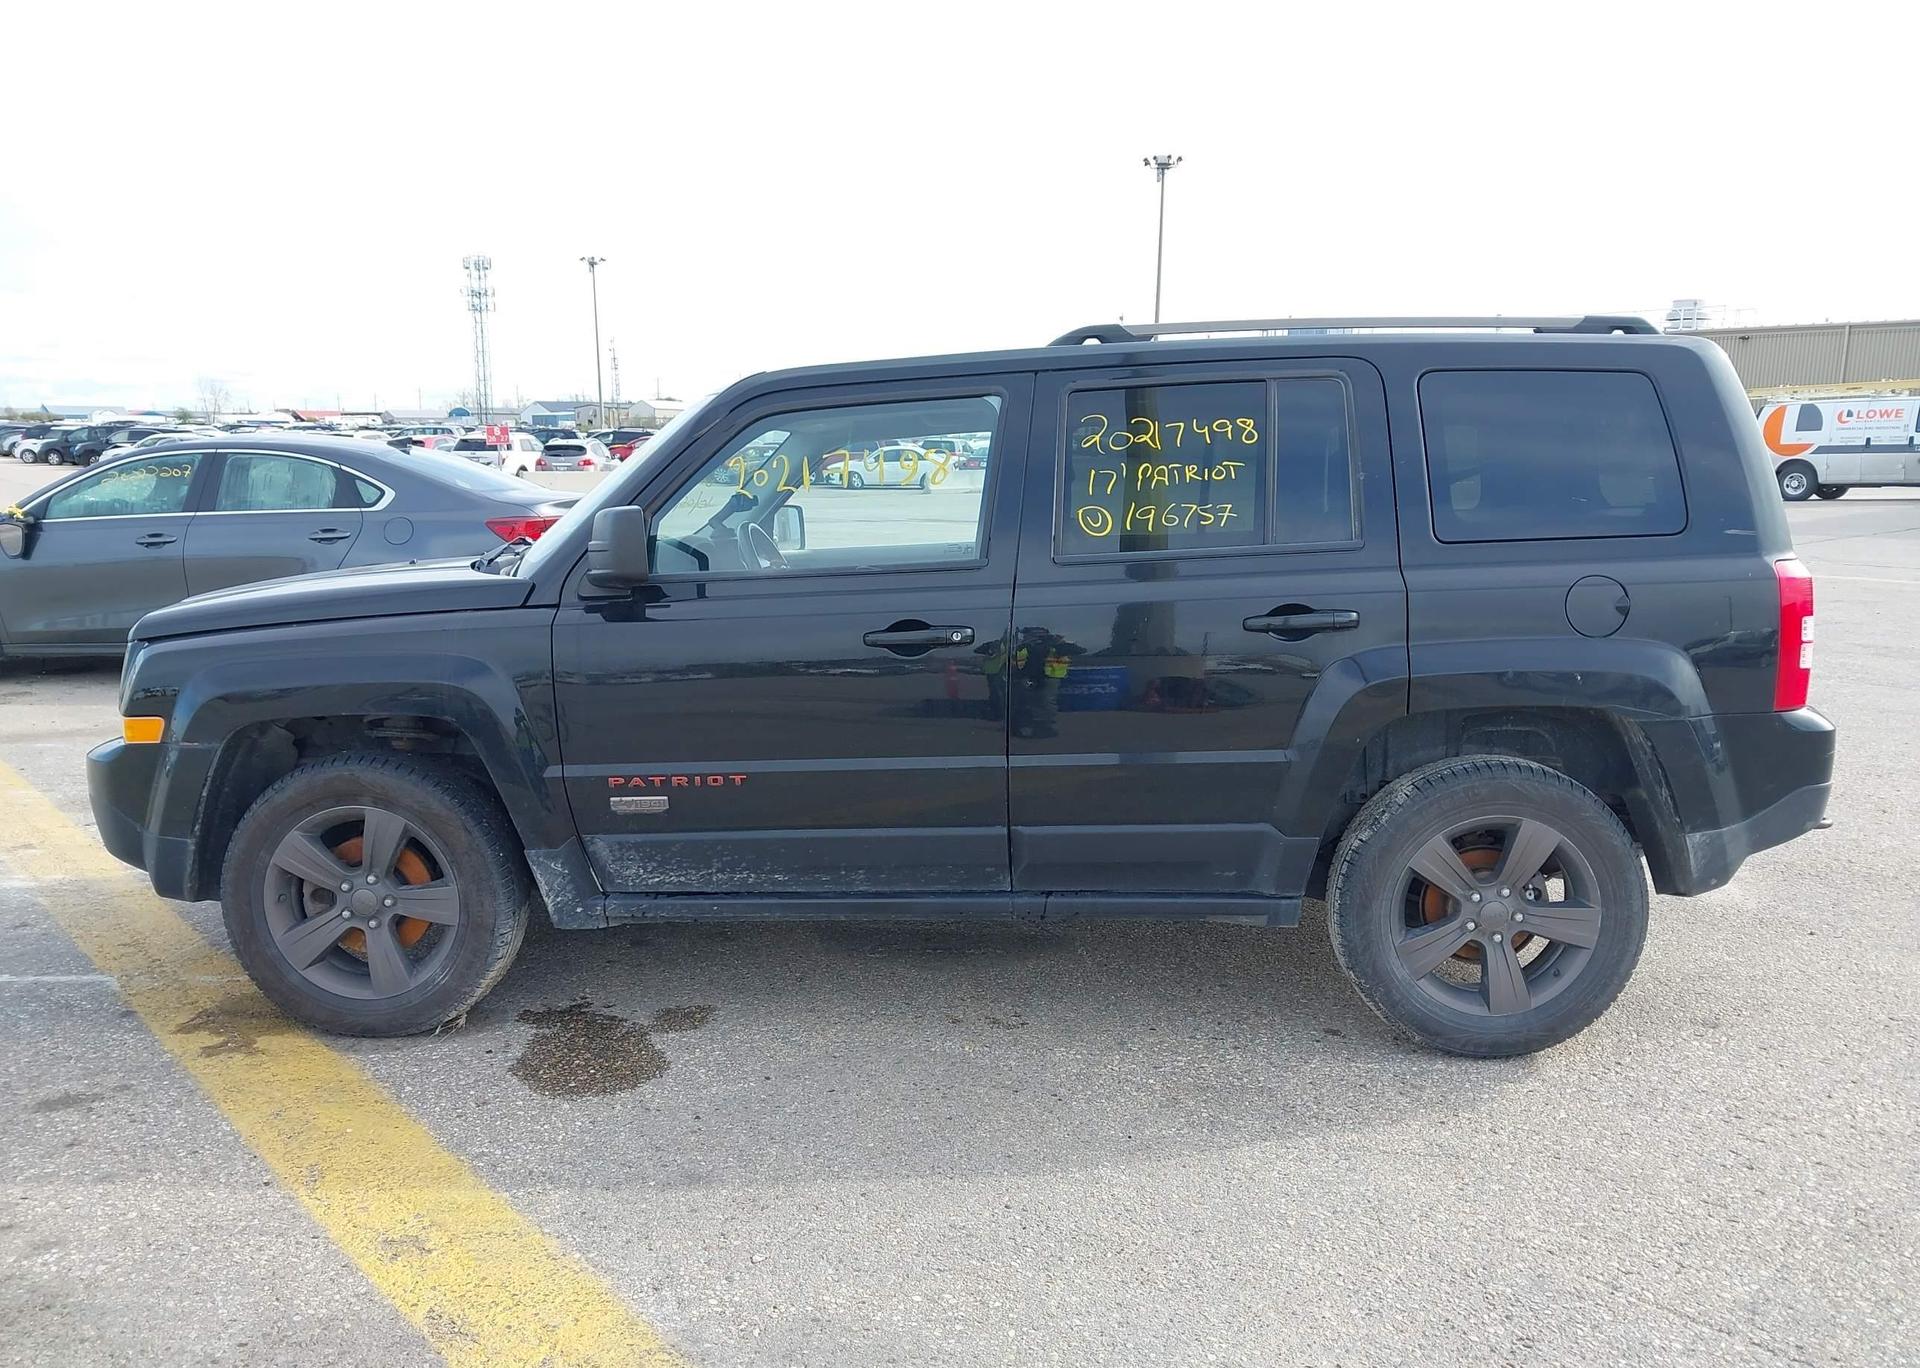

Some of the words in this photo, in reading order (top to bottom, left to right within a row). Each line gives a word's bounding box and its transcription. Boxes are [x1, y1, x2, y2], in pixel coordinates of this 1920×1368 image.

[1856, 408, 1904, 419] LOWE
[1080, 414, 1259, 455] 20217498
[1137, 461, 1246, 491] PATRIOT
[1125, 501, 1238, 532] 196757
[608, 775, 748, 788] PATRIOT
